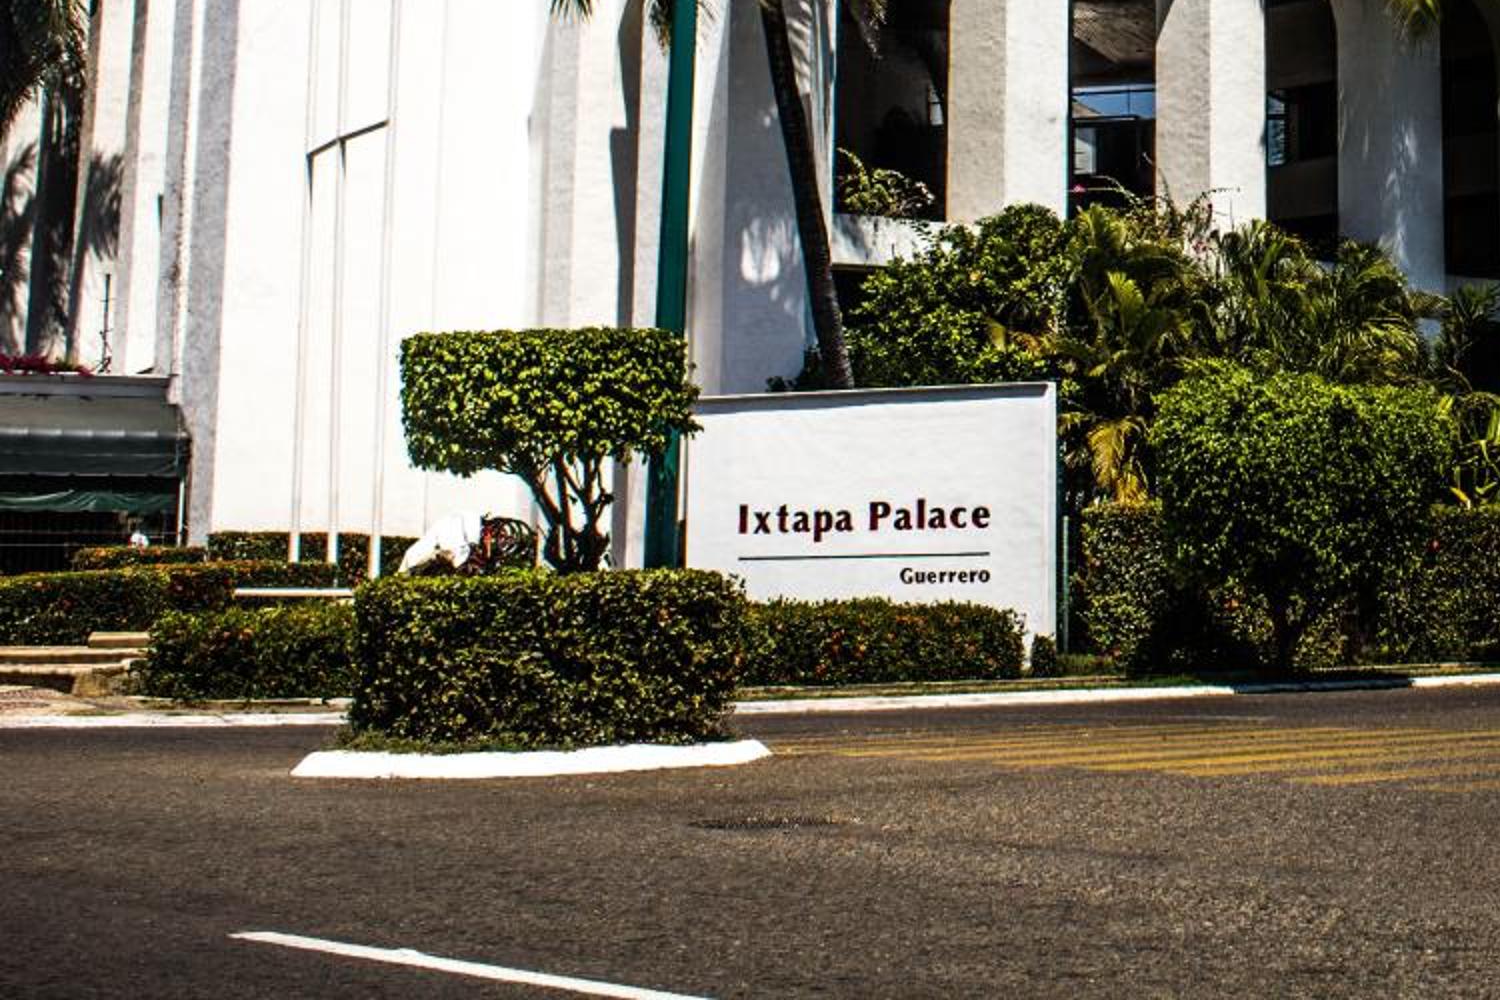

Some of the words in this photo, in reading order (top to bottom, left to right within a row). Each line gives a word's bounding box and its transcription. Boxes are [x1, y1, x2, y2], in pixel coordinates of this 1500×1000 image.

[738, 504, 853, 542] Ixtapa
[869, 498, 991, 531] Palace
[900, 567, 991, 585] Guerrero
